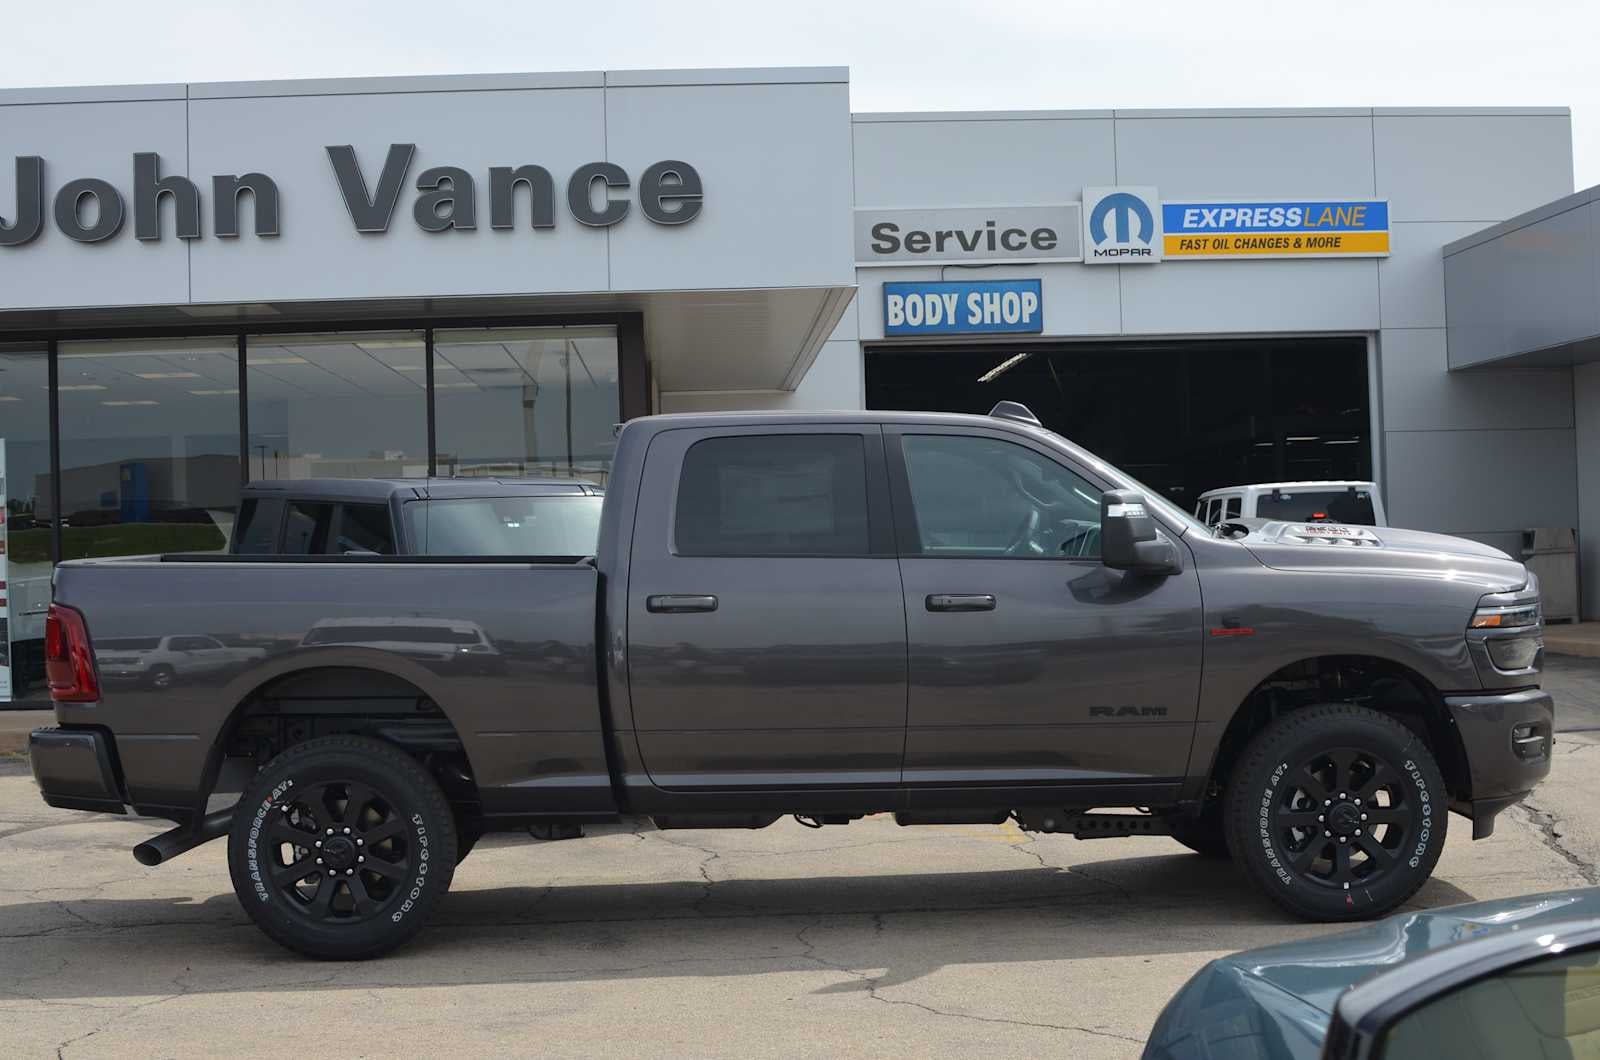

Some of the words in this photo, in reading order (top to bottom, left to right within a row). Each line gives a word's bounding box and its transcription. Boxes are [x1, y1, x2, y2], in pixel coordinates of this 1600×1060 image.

[0, 152, 281, 246] John
[325, 143, 704, 234] Vance
[871, 220, 1058, 255] Service
[1180, 238, 1210, 251] FAST
[1212, 238, 1231, 250] OIL
[1234, 237, 1291, 250] CHANGES
[1293, 237, 1302, 249] &
[1305, 236, 1342, 249] MORE
[1093, 248, 1152, 257] MOPAR
[887, 293, 959, 327] BODY
[966, 291, 1038, 325] SHOP
[1089, 706, 1167, 717] RAM
